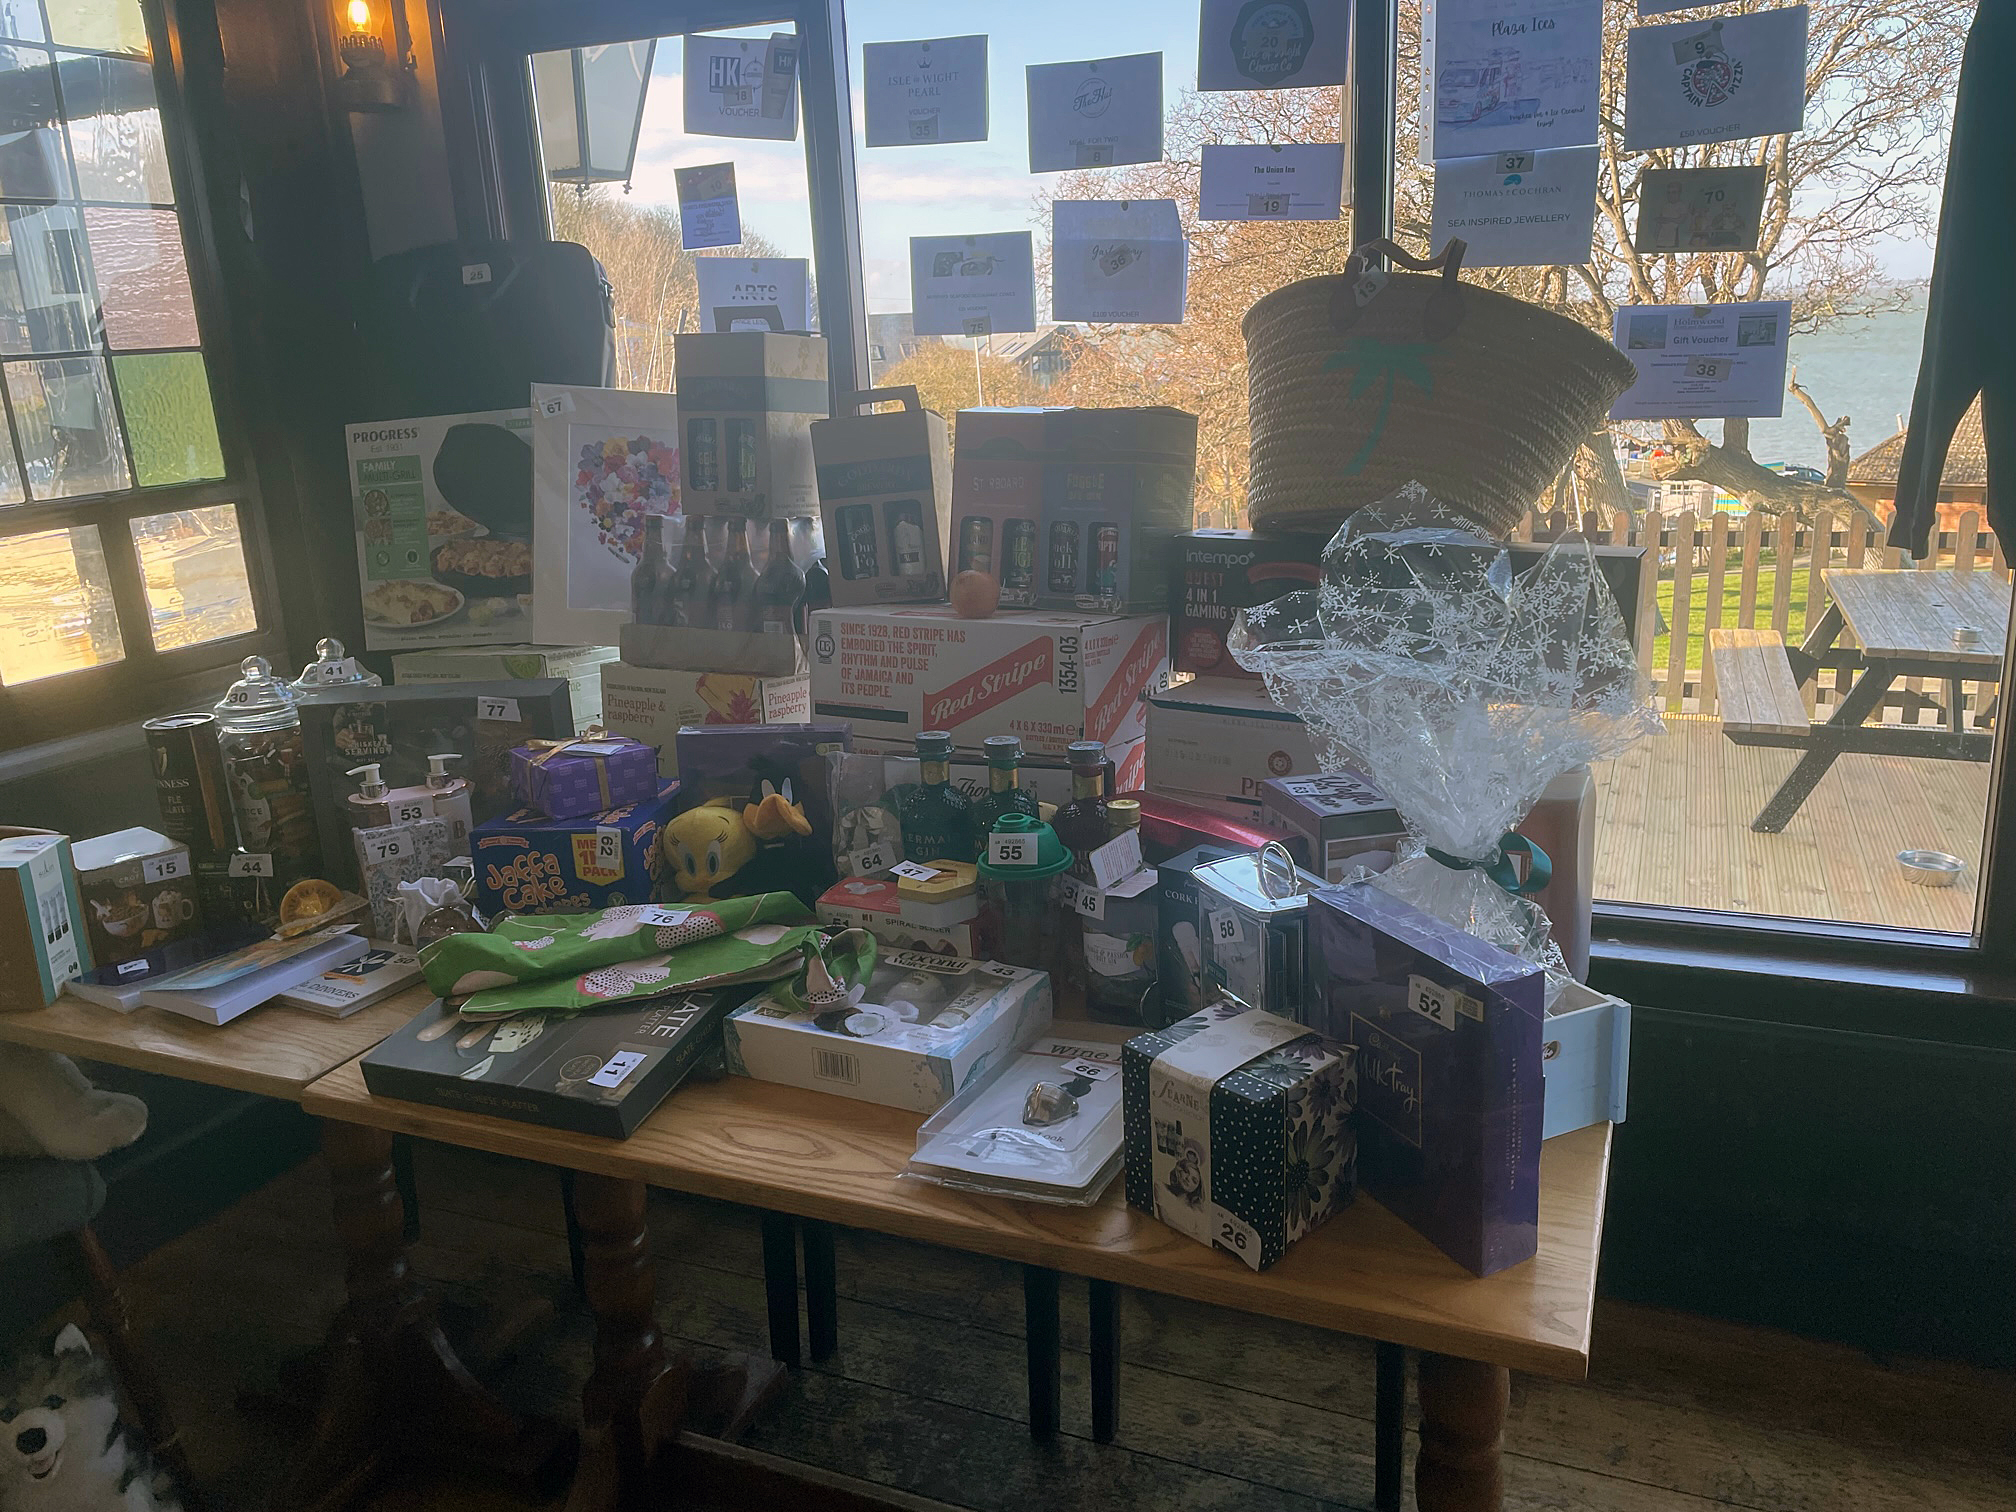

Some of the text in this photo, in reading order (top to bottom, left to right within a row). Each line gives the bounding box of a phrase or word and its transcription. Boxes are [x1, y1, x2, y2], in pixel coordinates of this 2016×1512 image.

[1491, 16, 1556, 37] Plaza Ices
[1261, 37, 1278, 48] 20
[1694, 41, 1706, 54] 9
[711, 58, 739, 86] HK
[888, 76, 911, 86] ISLE
[923, 72, 960, 84] WIGHT
[1727, 60, 1744, 96] PIZZA
[908, 87, 941, 97] PEARL
[1680, 67, 1704, 108] CAPTAIN
[736, 91, 747, 101] 18
[719, 107, 760, 117] VOUCHER
[908, 107, 941, 116] VOUCHER
[916, 126, 930, 136] 35
[1679, 123, 1741, 138] £50 VOUCHER
[1254, 166, 1264, 174] The
[1266, 166, 1284, 174] Union
[1505, 157, 1525, 169] 37
[710, 180, 722, 193] 10
[1463, 185, 1562, 200] THOMAS COCHRAN
[1704, 189, 1725, 204] 70
[1263, 201, 1280, 212] 19
[1447, 213, 1571, 228] SEA INSPIRED JEWELLERY
[1111, 257, 1125, 271] 36
[470, 271, 483, 280] 25
[1358, 282, 1377, 298] 13
[970, 323, 984, 334] 75
[1673, 335, 1729, 345] Gift Voucher
[1696, 364, 1716, 376] 38
[547, 402, 562, 414] 67
[353, 428, 418, 443] PROGRESS
[363, 461, 396, 473] FAMILY
[1186, 549, 1250, 568] Intempo
[1186, 587, 1217, 603] 4 IN 1
[1186, 603, 1227, 620] GAMING
[841, 622, 966, 643] SINCE 1928, RED STRIPE HAS
[841, 638, 938, 657] EMBODIED THE SPIRIT,
[841, 653, 929, 671] RHYTHM AND PULSE
[1059, 635, 1079, 695] 1354-03
[325, 665, 343, 676] 41
[841, 668, 914, 685] OF JAMAICA AND
[841, 683, 892, 699] ITS PEOPLE.
[930, 692, 975, 726] Red
[977, 652, 1046, 702] Stripe
[1093, 683, 1122, 740] Red
[1122, 629, 1161, 697] Stripe
[229, 692, 248, 703] 30
[607, 694, 666, 712] Pineapple &
[768, 687, 807, 706] Pineapple
[487, 705, 506, 717] 77
[608, 709, 655, 726] raspberry
[769, 703, 807, 719] raspberry
[1009, 718, 1015, 730] 4
[1016, 719, 1022, 731] X
[1023, 720, 1029, 732] 6
[1030, 721, 1036, 733] X
[345, 747, 385, 756] SERVING
[160, 778, 190, 788] NNESS
[401, 807, 422, 820] 53
[377, 843, 399, 858] 79
[577, 840, 597, 849] ME
[601, 836, 613, 856] 62
[1000, 845, 1023, 860] 55
[242, 862, 262, 873] 44
[861, 853, 883, 869] 64
[156, 862, 177, 876] 15
[486, 851, 561, 890] Jaffa
[584, 867, 617, 876] PACK
[901, 868, 923, 877] 47
[503, 874, 568, 910] Cake
[1165, 890, 1193, 905] CORK
[1082, 896, 1096, 911] 45
[652, 914, 674, 923] 76
[886, 918, 916, 929] SPIRAL
[1220, 920, 1234, 938] 58
[893, 958, 927, 969] Water
[899, 951, 970, 968] Coconut
[992, 967, 1016, 976] 43
[308, 983, 360, 999] DINNERS
[1419, 992, 1442, 1020] 52
[632, 1003, 668, 1035] PLATTER
[1050, 1044, 1110, 1060] Wine
[1075, 1065, 1102, 1077] 66
[1385, 1062, 1419, 1114] Tray
[1221, 1223, 1248, 1249] 26
